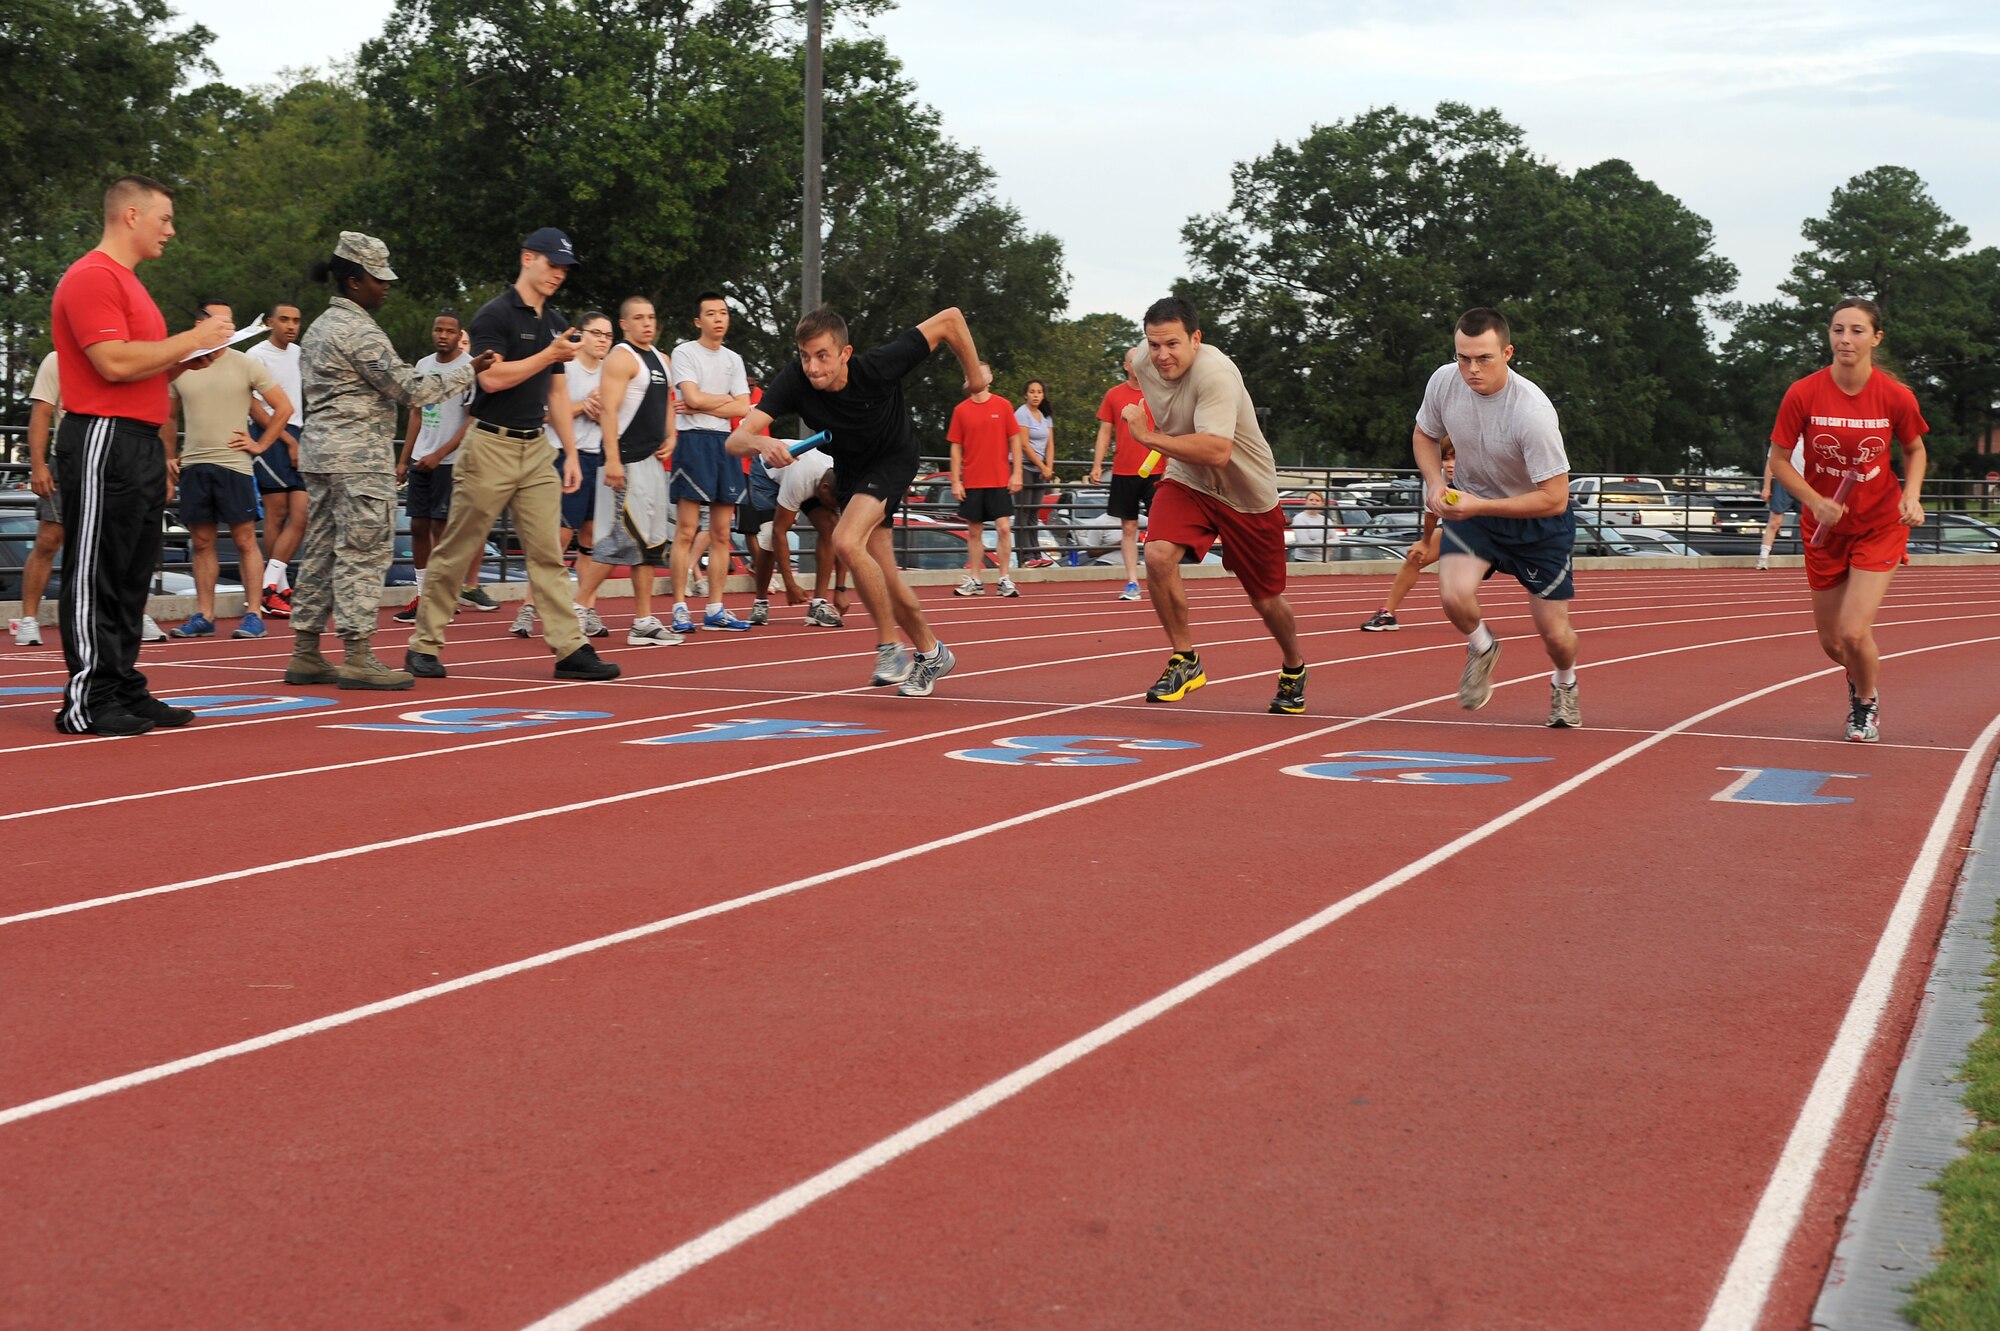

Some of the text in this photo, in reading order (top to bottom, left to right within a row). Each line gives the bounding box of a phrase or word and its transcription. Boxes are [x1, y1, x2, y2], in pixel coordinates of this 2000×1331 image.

[1815, 416, 1828, 426] YOU
[1847, 418, 1864, 429] TAKE
[1864, 418, 1876, 429] THE
[1826, 467, 1840, 477] OUT
[620, 718, 889, 746] 4
[943, 735, 1203, 767] 3
[1279, 750, 1556, 785] 2
[1710, 766, 1872, 806] 1
